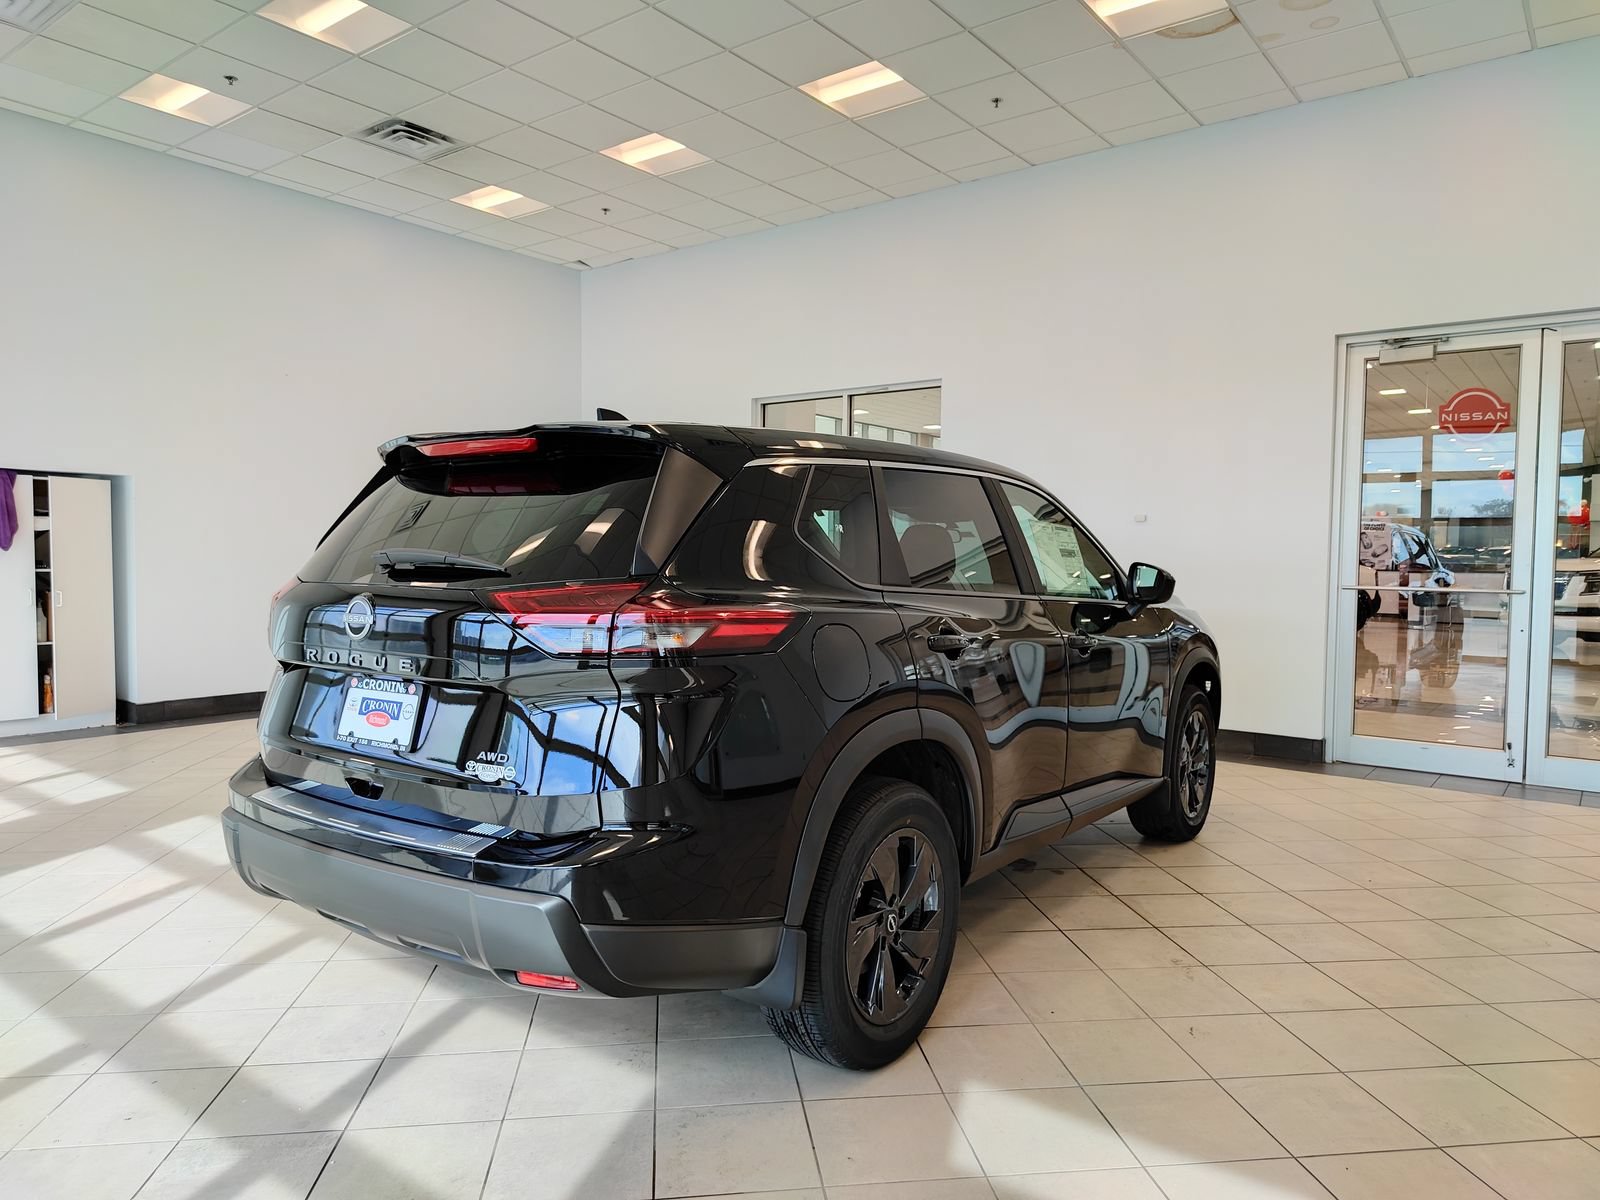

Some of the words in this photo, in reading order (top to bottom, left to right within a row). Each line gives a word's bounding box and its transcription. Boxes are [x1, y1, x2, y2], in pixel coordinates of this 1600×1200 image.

[1441, 411, 1508, 422] NISSAN
[306, 648, 414, 672] ROGUE
[363, 679, 404, 693] CRONIN
[362, 699, 400, 718] CRONIN
[476, 751, 508, 763] AWD
